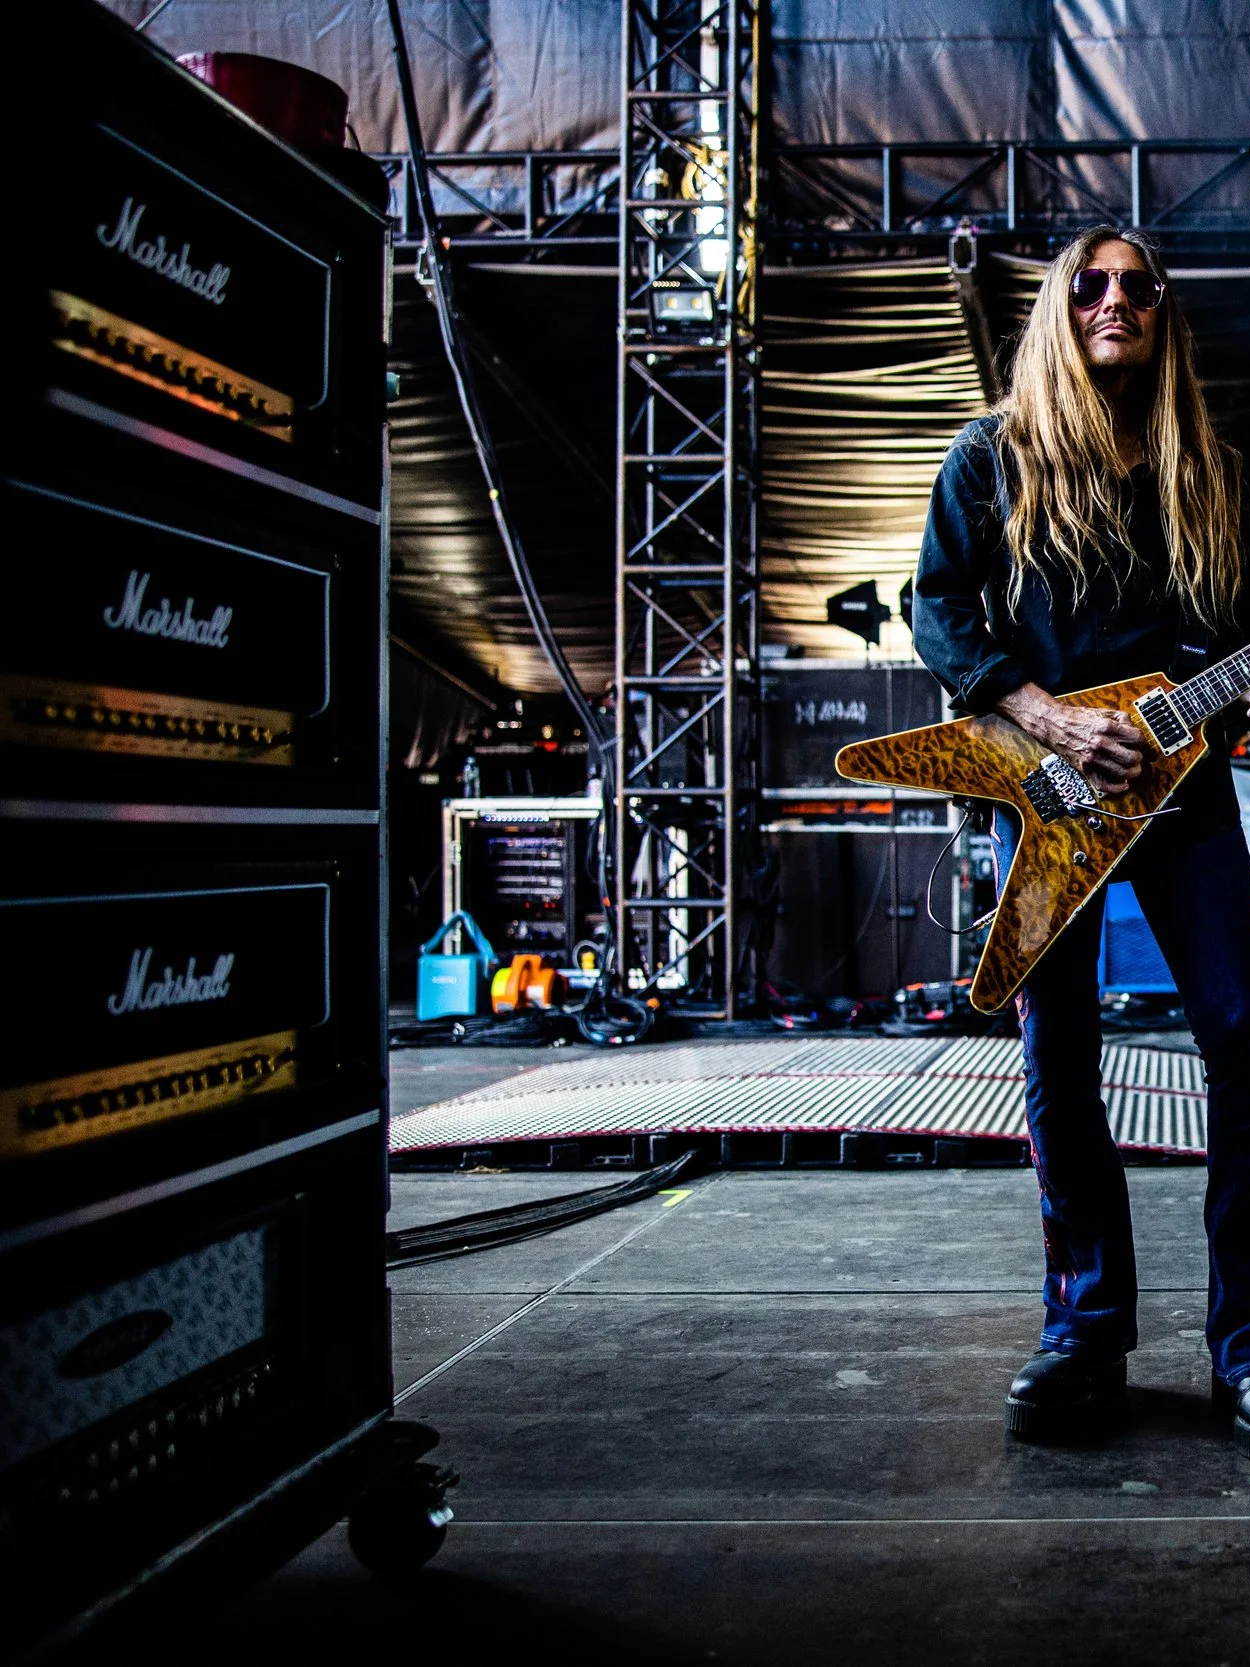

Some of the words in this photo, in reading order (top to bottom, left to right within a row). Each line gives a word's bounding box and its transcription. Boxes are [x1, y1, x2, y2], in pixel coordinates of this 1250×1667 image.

[95, 195, 232, 307] Marshall
[102, 568, 234, 650] Marshall
[106, 945, 236, 1017] Marshall
